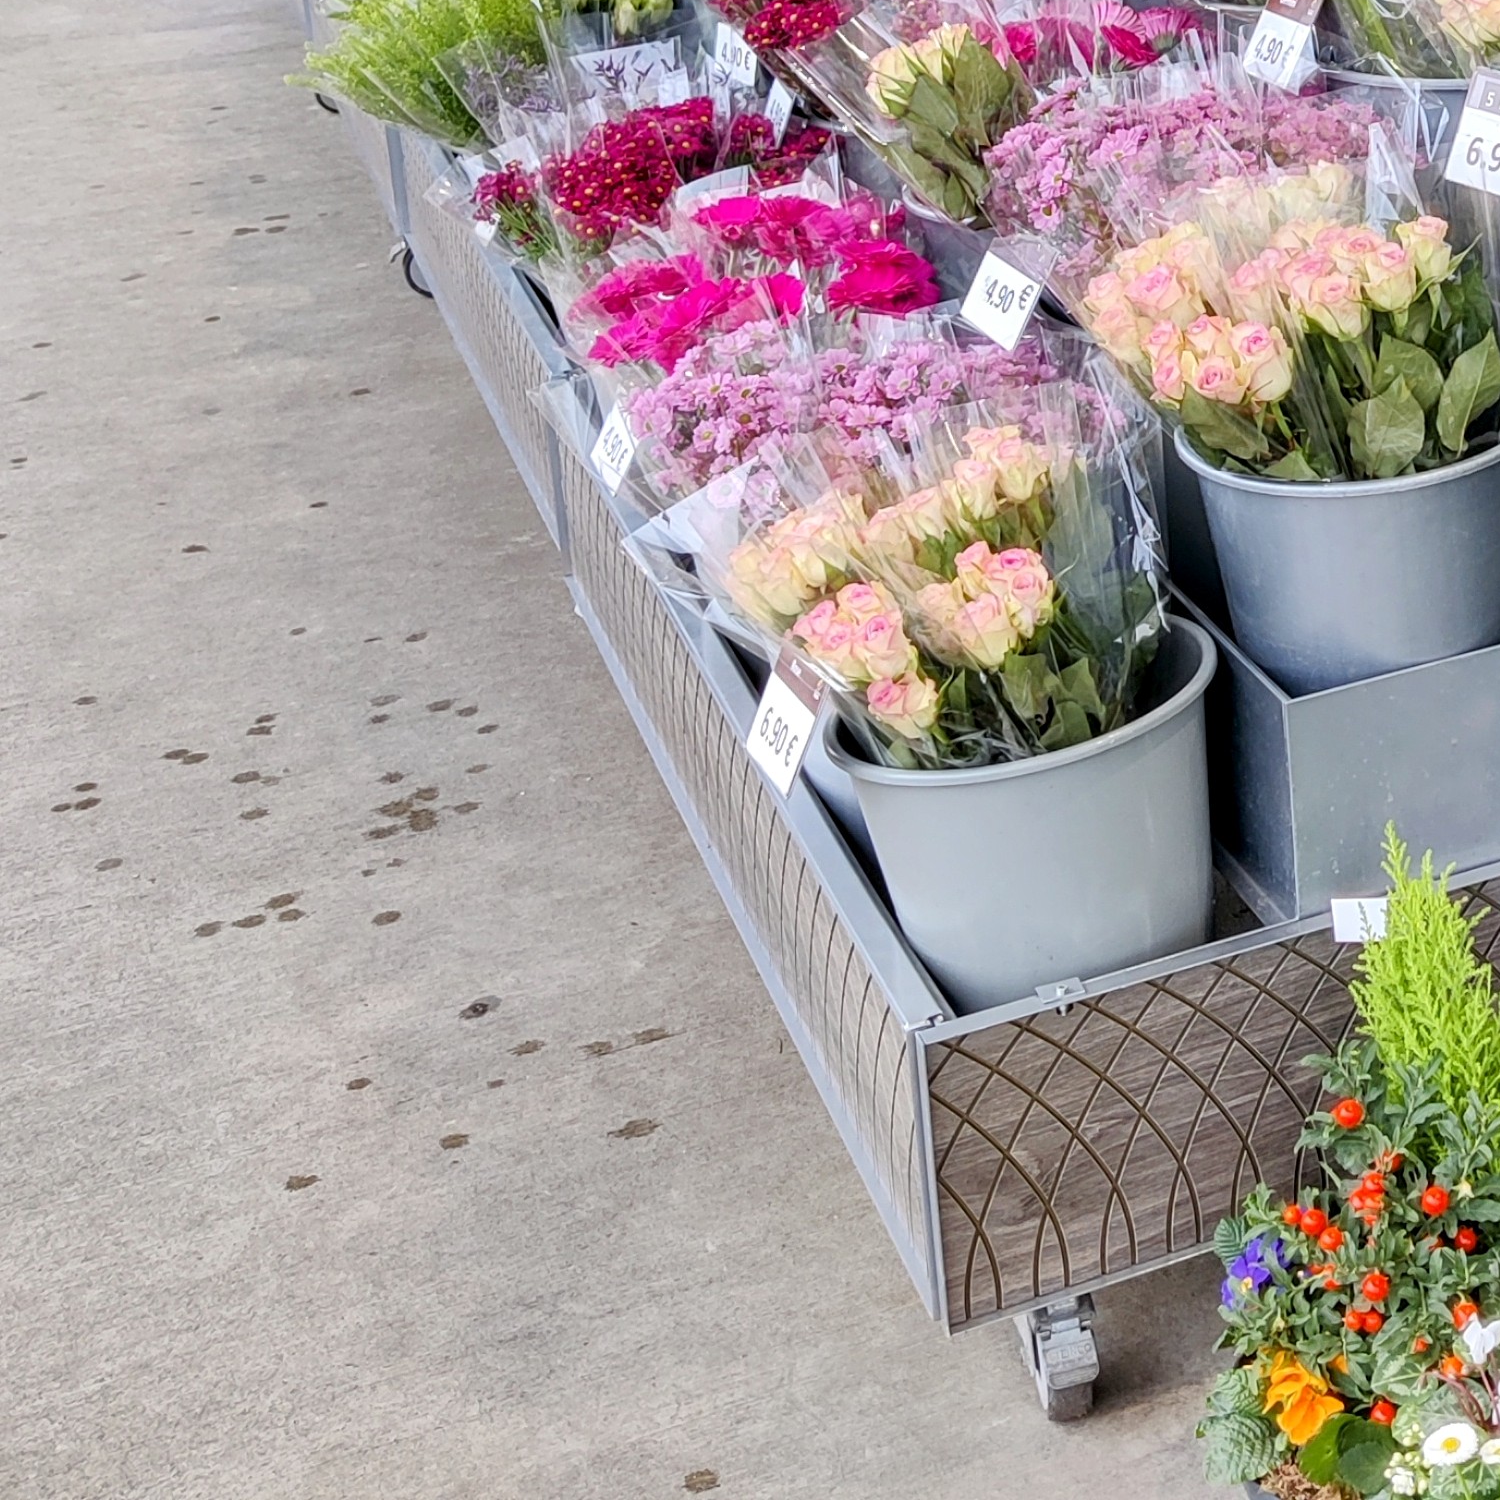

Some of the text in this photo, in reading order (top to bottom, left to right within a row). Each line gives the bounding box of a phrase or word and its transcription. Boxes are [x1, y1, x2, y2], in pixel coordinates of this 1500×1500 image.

[1485, 91, 1496, 107] 5
[985, 279, 1015, 314] 4.90
[760, 706, 789, 756] 6.90
